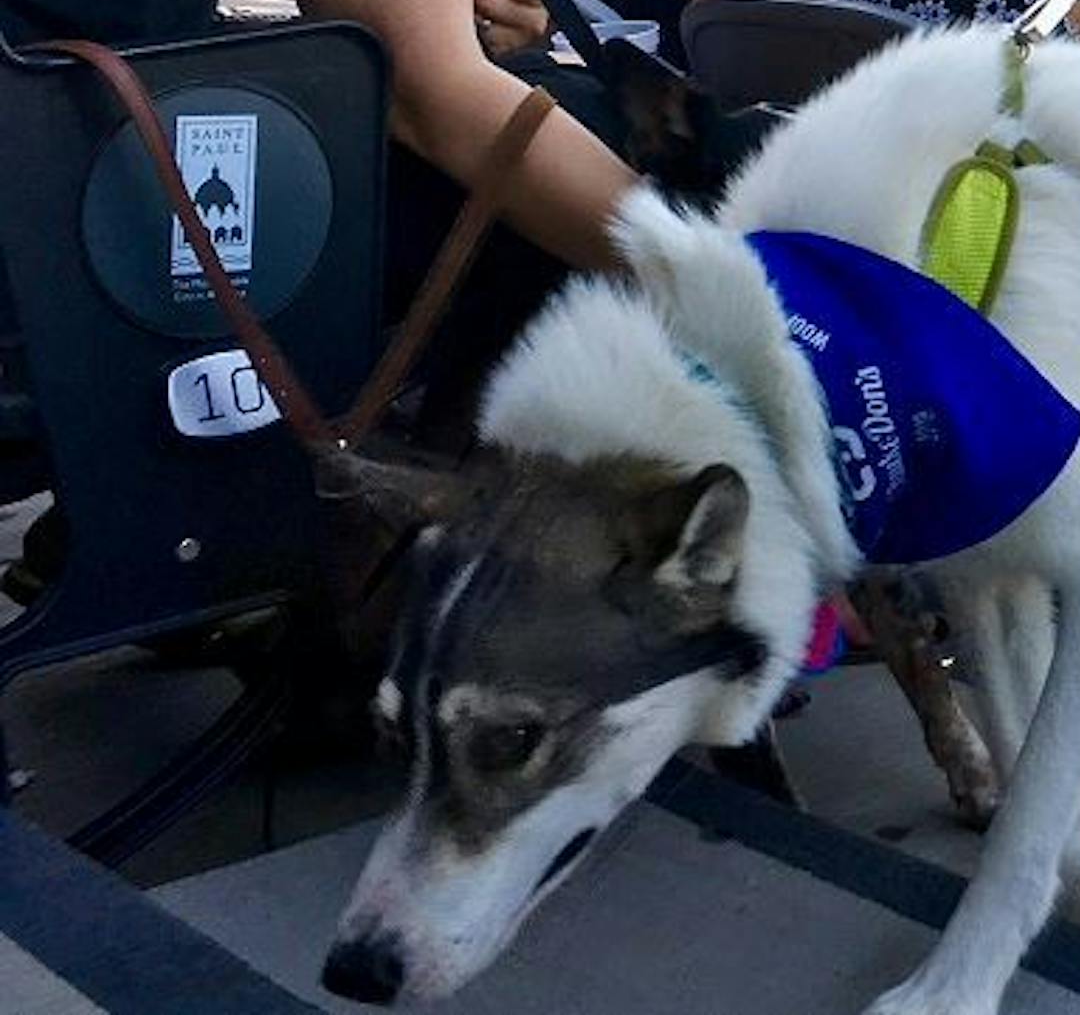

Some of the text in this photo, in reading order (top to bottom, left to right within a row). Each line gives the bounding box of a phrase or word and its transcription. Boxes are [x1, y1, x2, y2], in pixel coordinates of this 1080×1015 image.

[191, 128, 244, 140] SAINT
[191, 143, 244, 156] PAUL
[194, 366, 265, 423] 10
